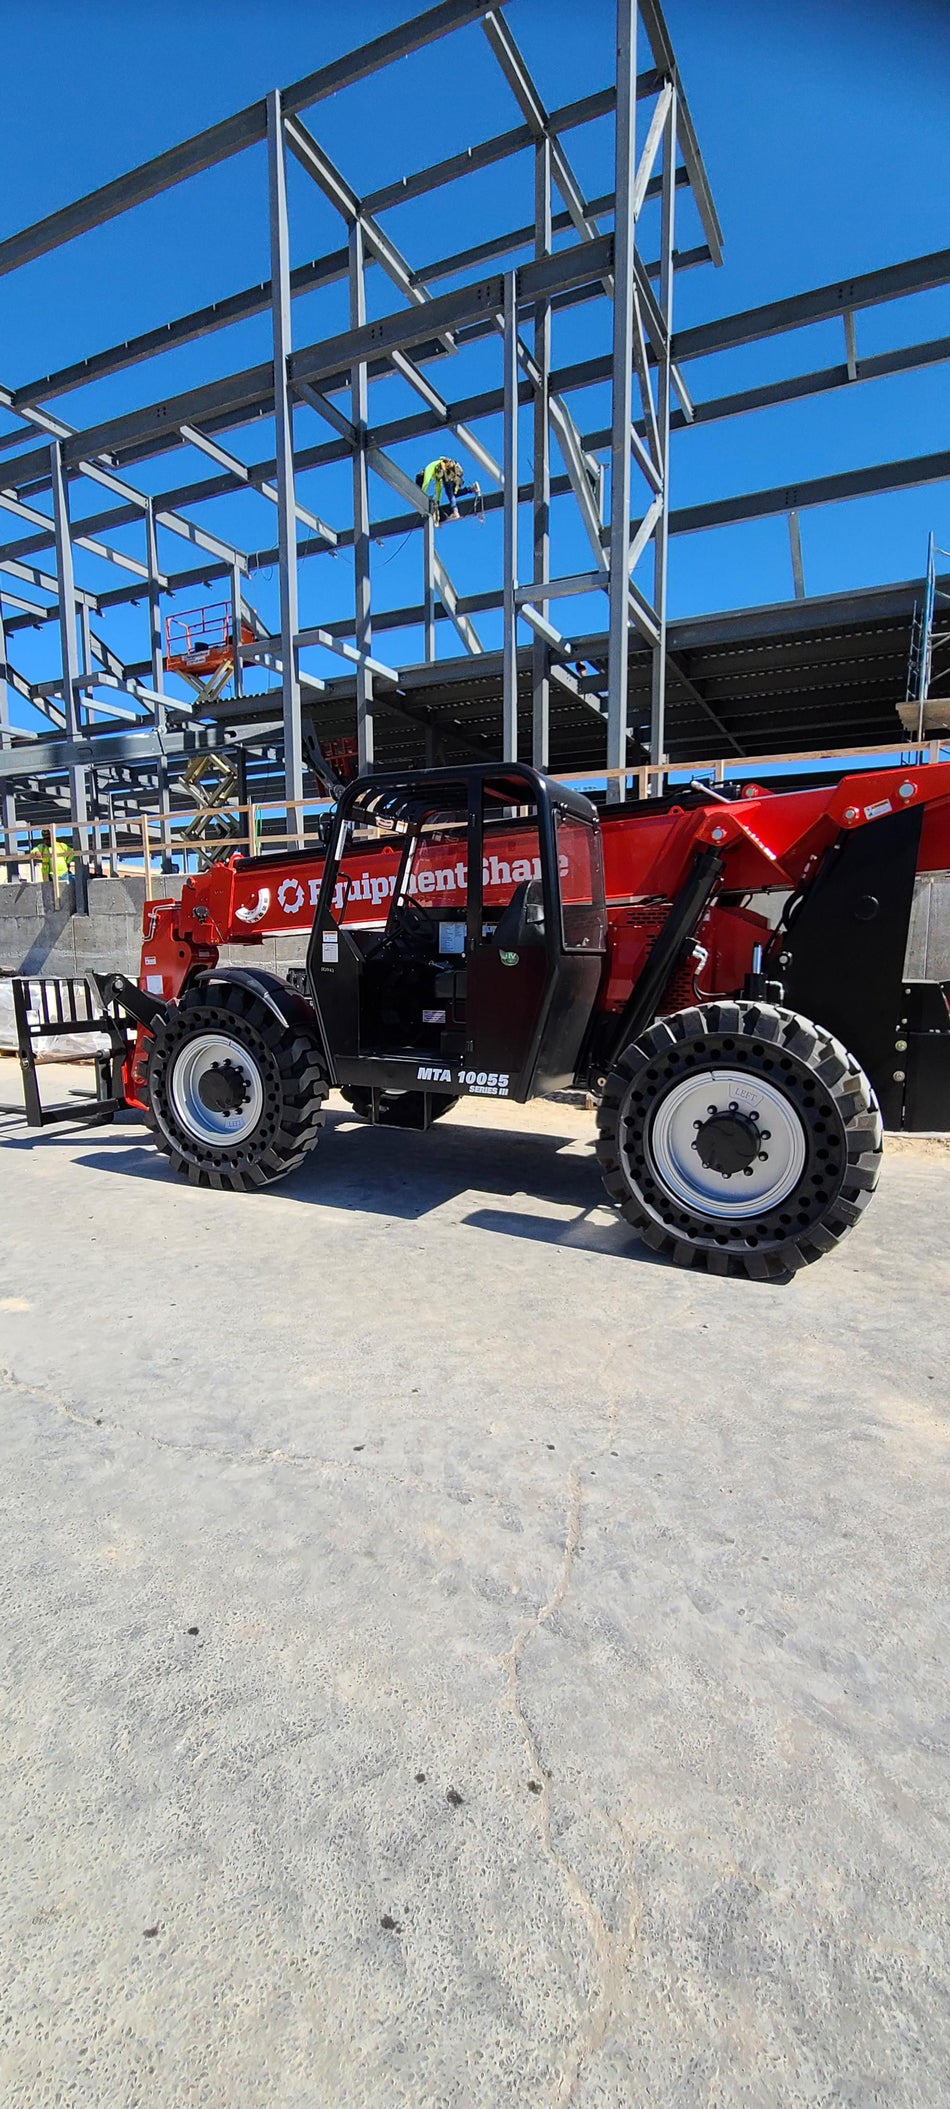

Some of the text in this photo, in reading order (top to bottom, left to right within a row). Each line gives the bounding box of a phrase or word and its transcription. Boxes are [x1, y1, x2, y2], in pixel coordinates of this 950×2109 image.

[417, 1067, 510, 1087] MTA 10055
[469, 1085, 509, 1096] SERIES III
[735, 1087, 757, 1101] LEFT
